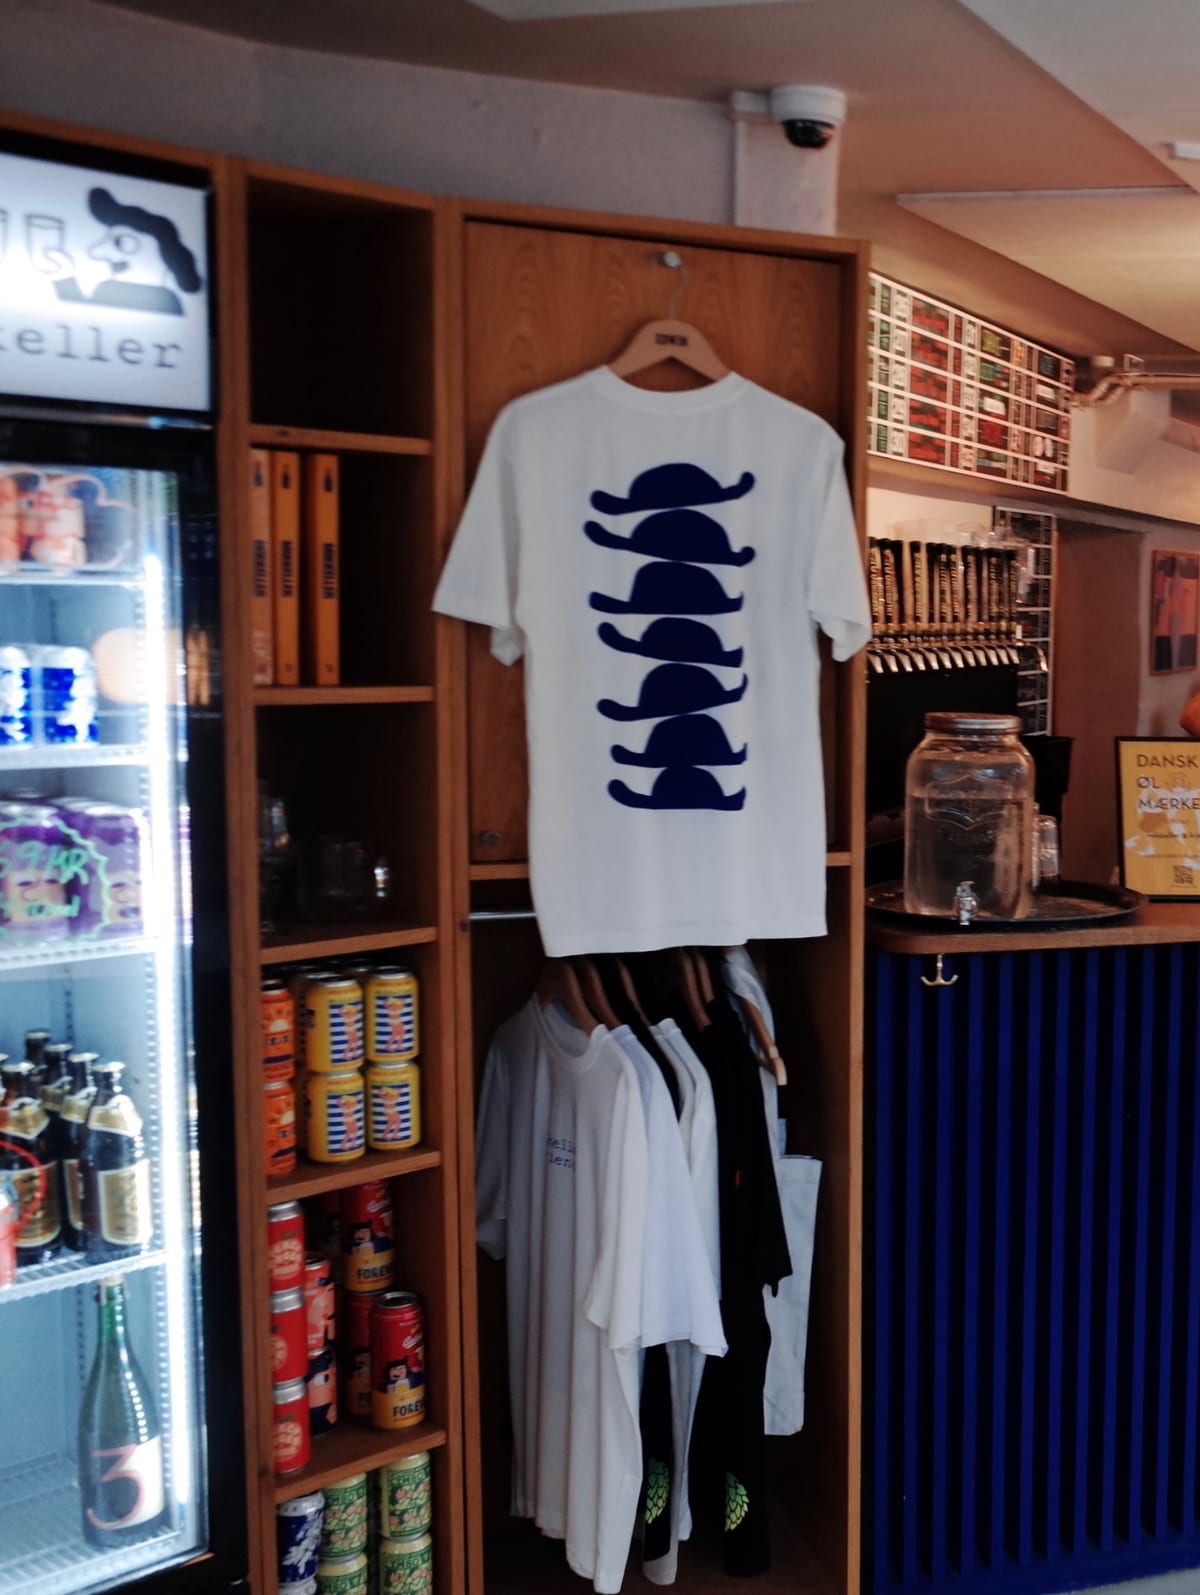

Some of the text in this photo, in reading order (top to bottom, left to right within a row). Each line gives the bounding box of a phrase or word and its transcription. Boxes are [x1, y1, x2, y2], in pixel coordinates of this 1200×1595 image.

[1136, 754, 1200, 768] DANSK
[1136, 776, 1161, 789] ØL
[1138, 798, 1200, 810] MÆRKE
[88, 1444, 145, 1530] 3
